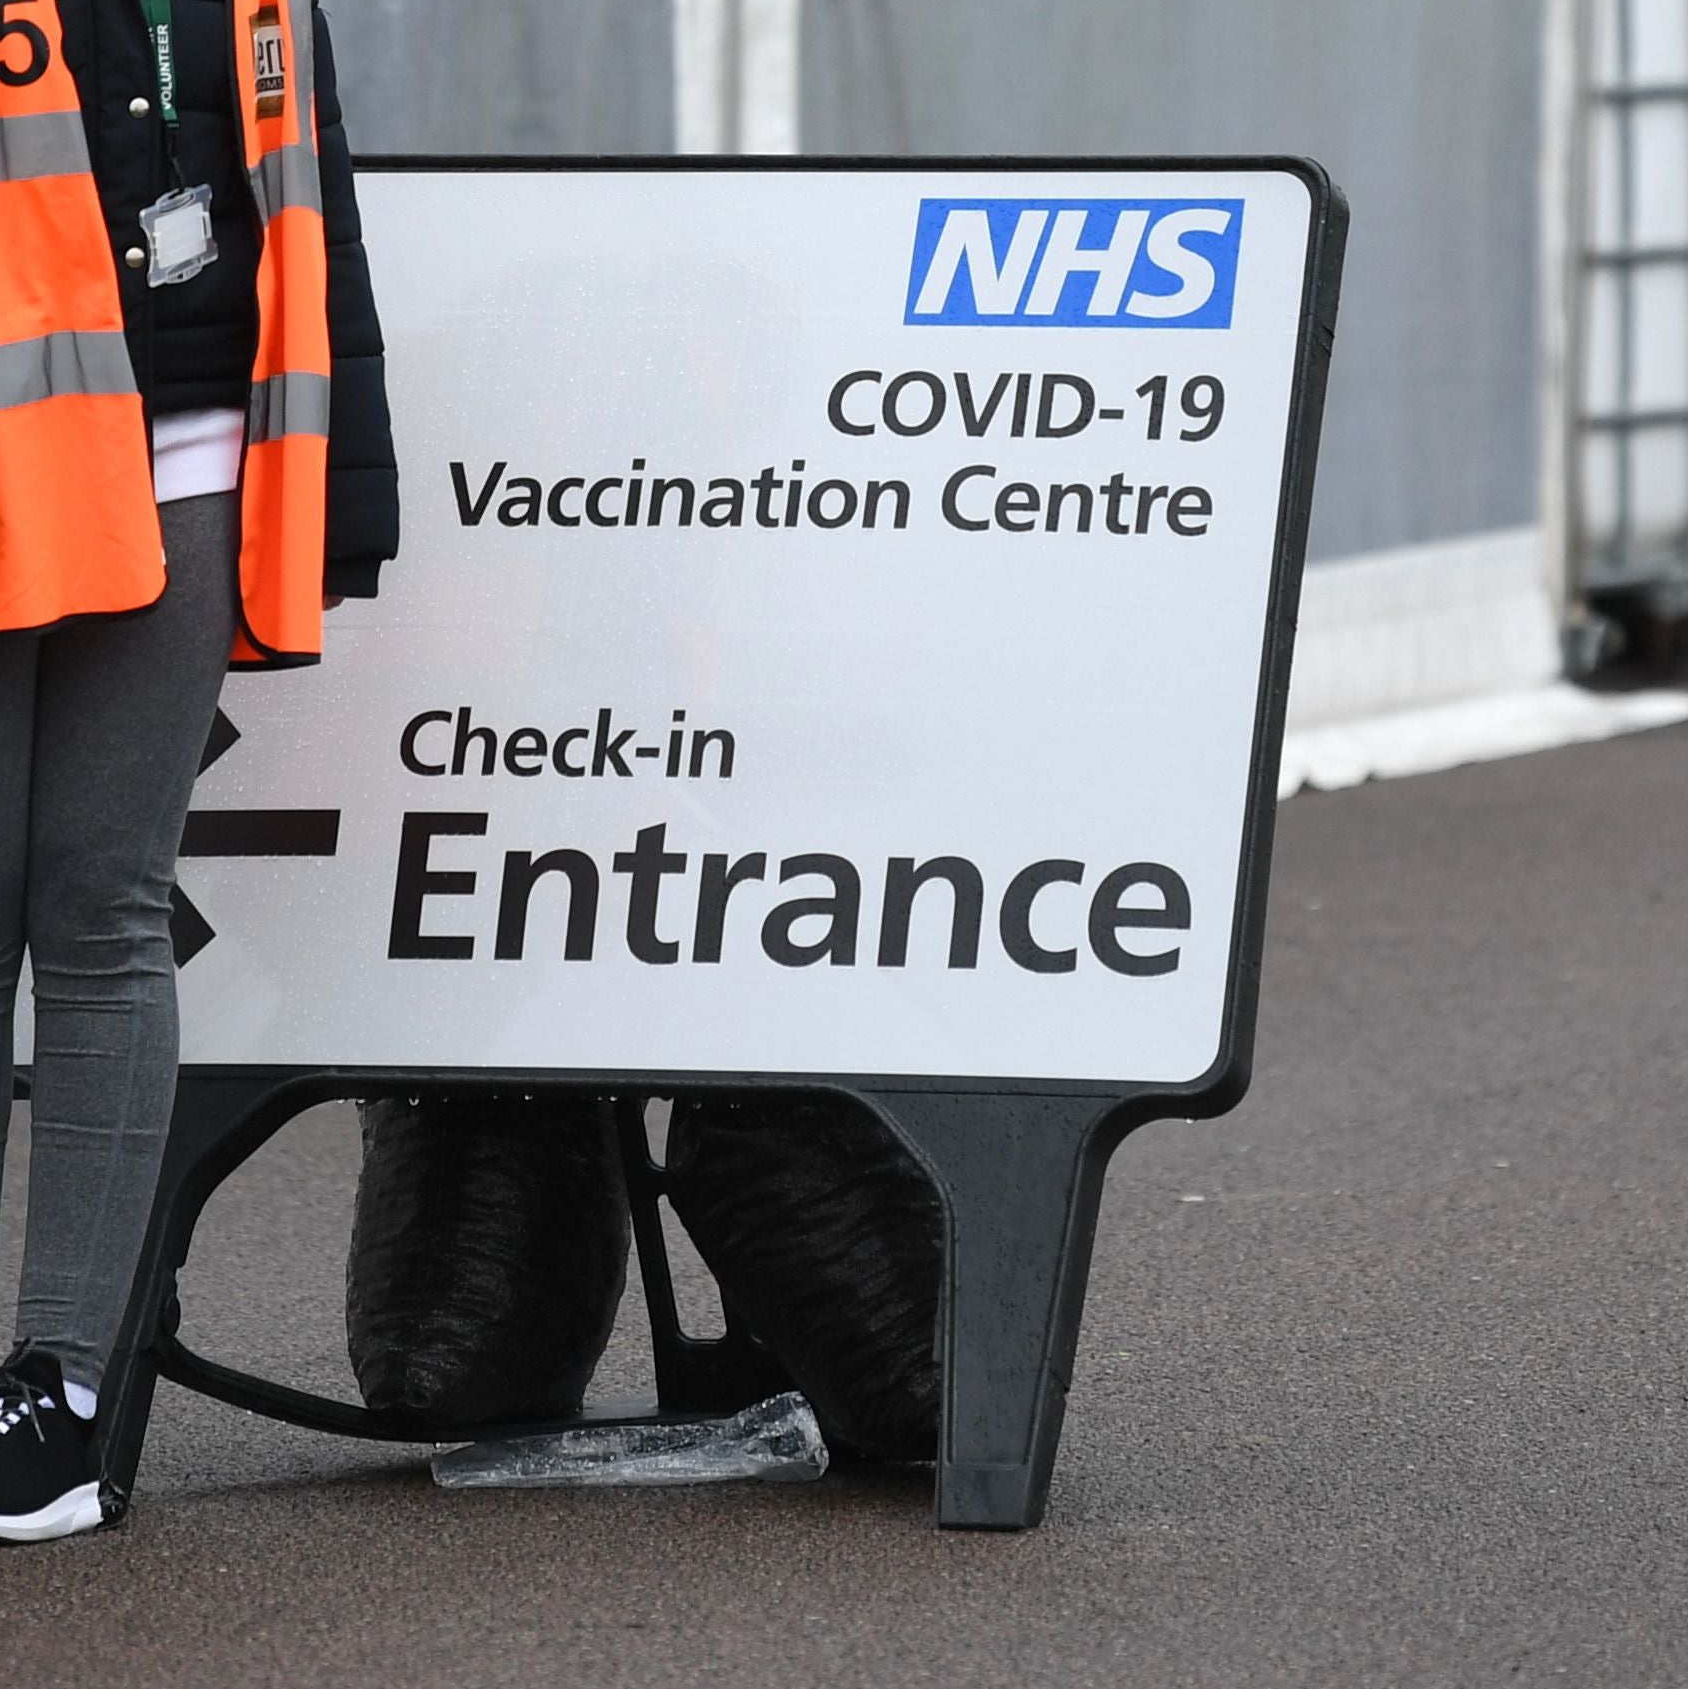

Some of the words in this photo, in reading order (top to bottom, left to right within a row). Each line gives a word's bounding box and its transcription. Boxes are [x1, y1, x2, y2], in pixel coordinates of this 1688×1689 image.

[156, 23, 173, 111] VOLUNTEER
[915, 207, 1234, 320] NHS
[827, 370, 1225, 442] COVID-19
[449, 458, 911, 529] Vaccination
[941, 464, 1214, 537] Centre
[399, 706, 735, 779] Check-in
[387, 811, 1192, 977] Entrance
